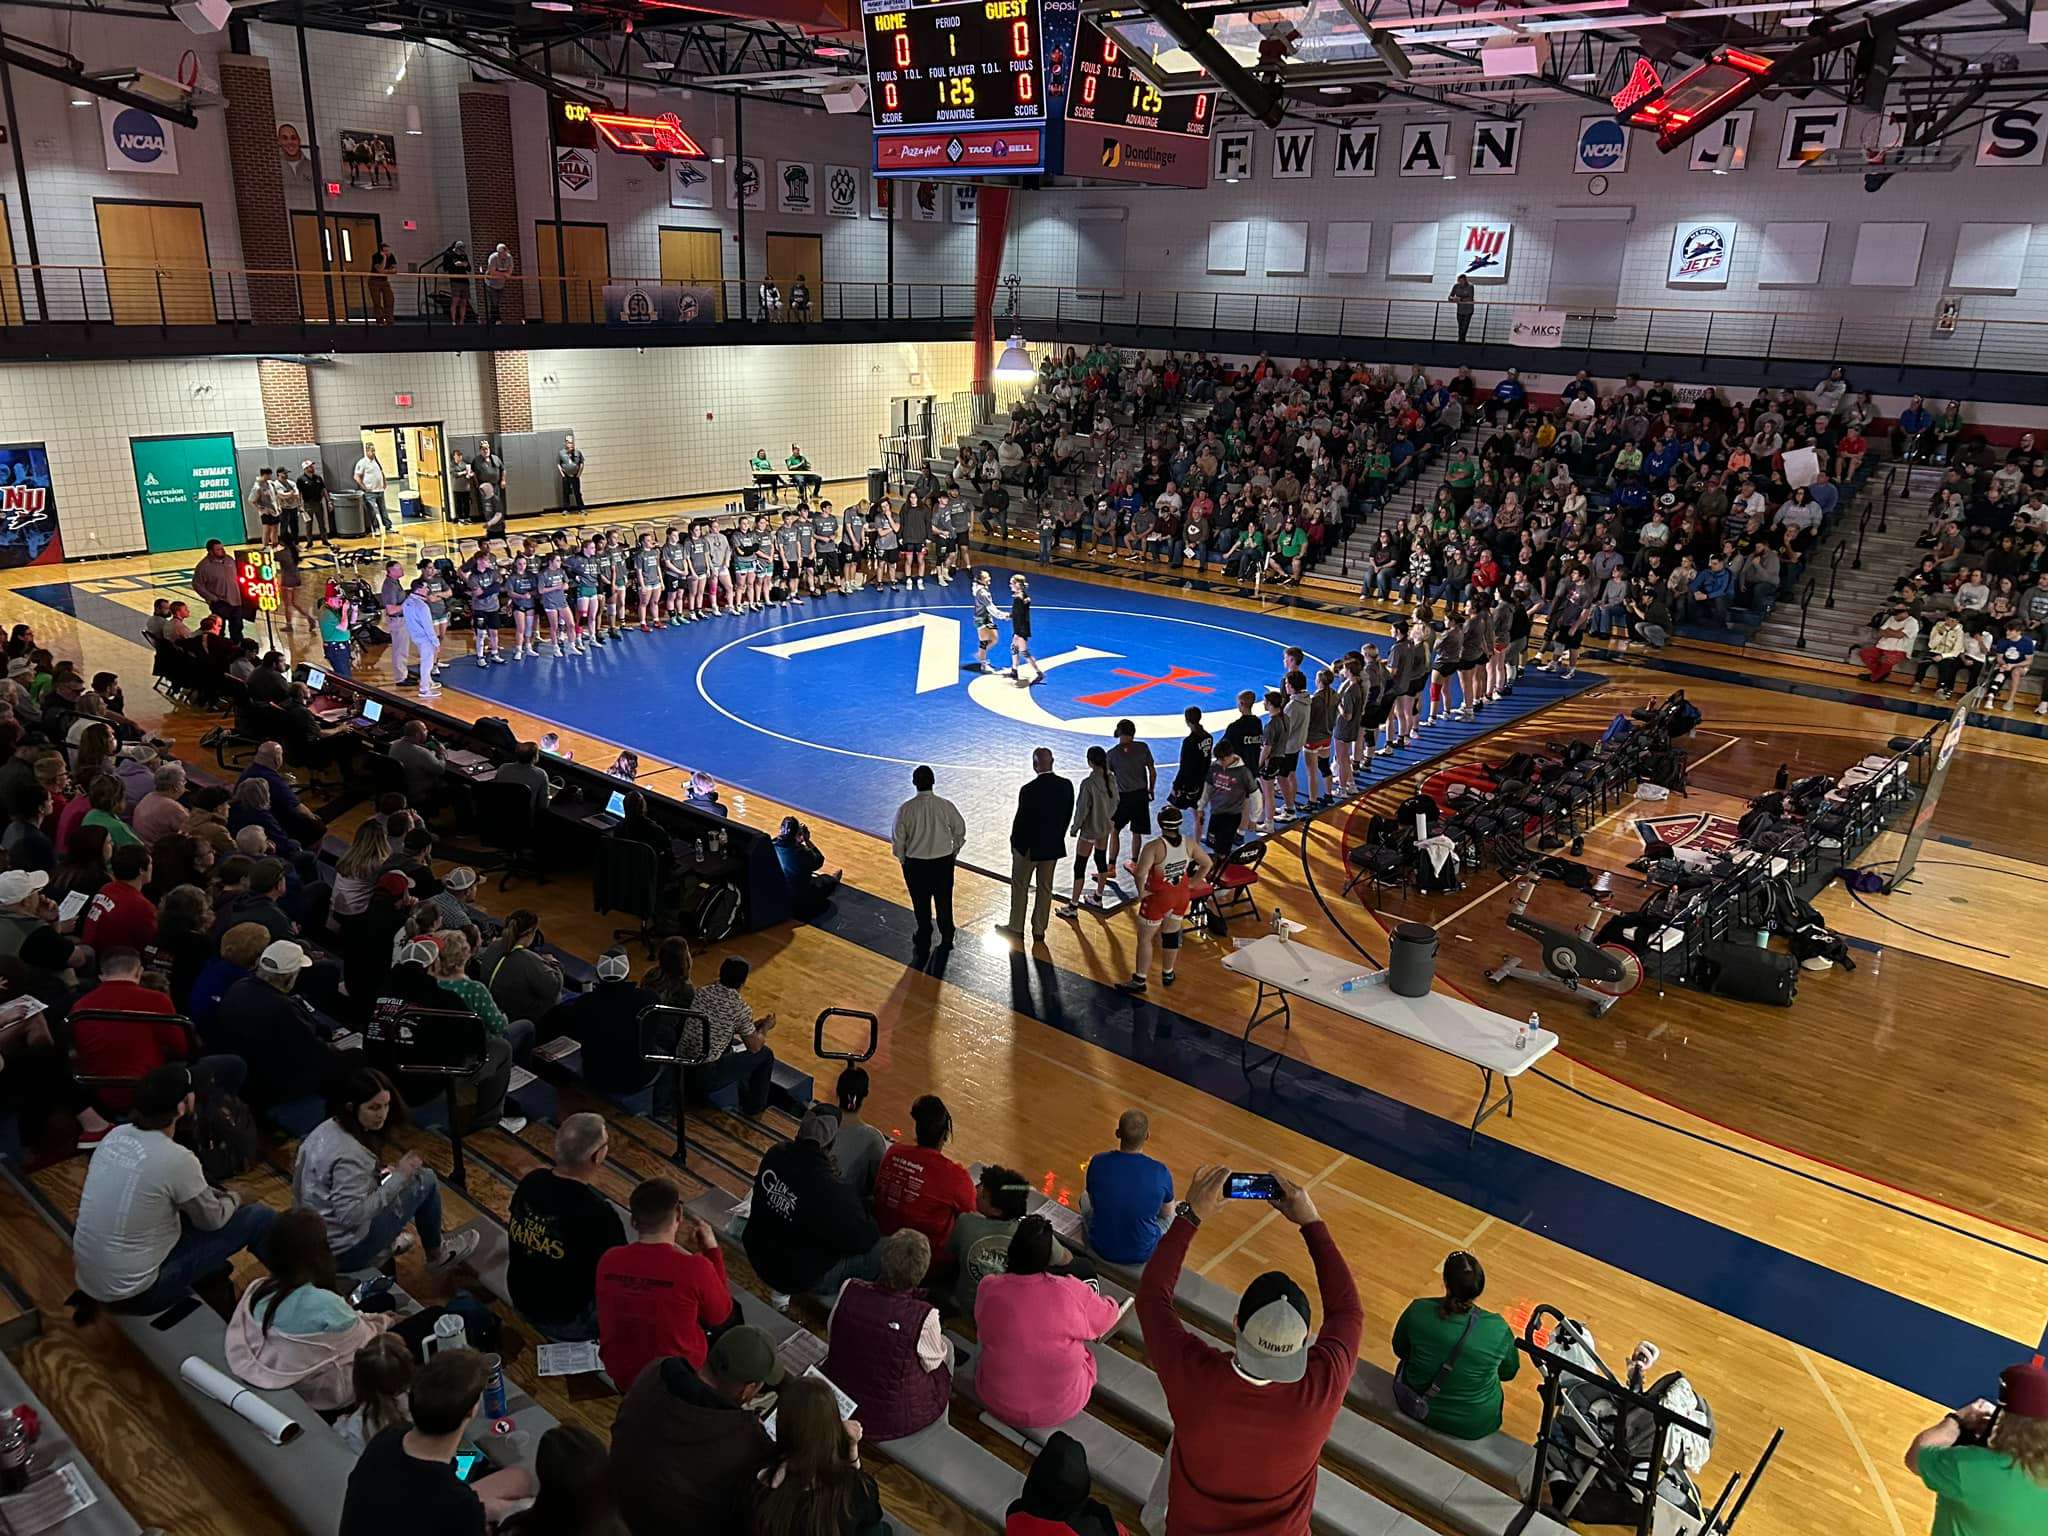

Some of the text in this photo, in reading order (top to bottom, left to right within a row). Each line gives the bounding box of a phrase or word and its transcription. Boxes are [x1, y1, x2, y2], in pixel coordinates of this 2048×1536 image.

[985, 0, 1028, 19] GUEST
[875, 12, 907, 31] HOME
[936, 16, 960, 28] PERIOD
[949, 34, 956, 57] 1
[1012, 21, 1029, 56] 0
[895, 33, 911, 66] 0
[929, 64, 975, 78] FOUL PLAYER
[982, 63, 1001, 74] T.O.L.
[1010, 60, 1033, 72] FOULS
[1080, 61, 1101, 75] FOULS
[877, 70, 897, 82] FOULS
[904, 69, 922, 80] T.O.L.
[938, 77, 975, 105] 125
[1018, 73, 1033, 99] 0
[1083, 76, 1097, 103] 0
[885, 82, 898, 107] 0
[1014, 104, 1038, 116] SCORE
[1074, 106, 1095, 119] SCORE
[1194, 94, 1208, 119] 0
[882, 112, 903, 123] SCORE
[936, 109, 975, 120] ADVANTAGE
[1125, 114, 1158, 127] ADVANTAGE
[1187, 122, 1205, 134] SCORE
[120, 133, 164, 151] NCAA
[968, 144, 1033, 154] TACO BELL
[901, 145, 942, 159] Pizza Hut
[1125, 143, 1177, 167] Dondlinger
[1582, 142, 1625, 158] NCAA
[1464, 225, 1506, 257] NU
[1680, 256, 1722, 273] JETS
[1531, 325, 1561, 336] MKCS
[192, 466, 233, 477] NEWMAN'S
[200, 478, 230, 488] SPORTS
[3, 484, 46, 513] NU
[146, 488, 184, 496] Ascension
[198, 489, 234, 499] MEDICINE
[147, 495, 187, 505] Via Christi
[200, 501, 236, 511] PROVIDER
[523, 1217, 546, 1236] TEAM
[510, 1217, 565, 1260] KANSAS
